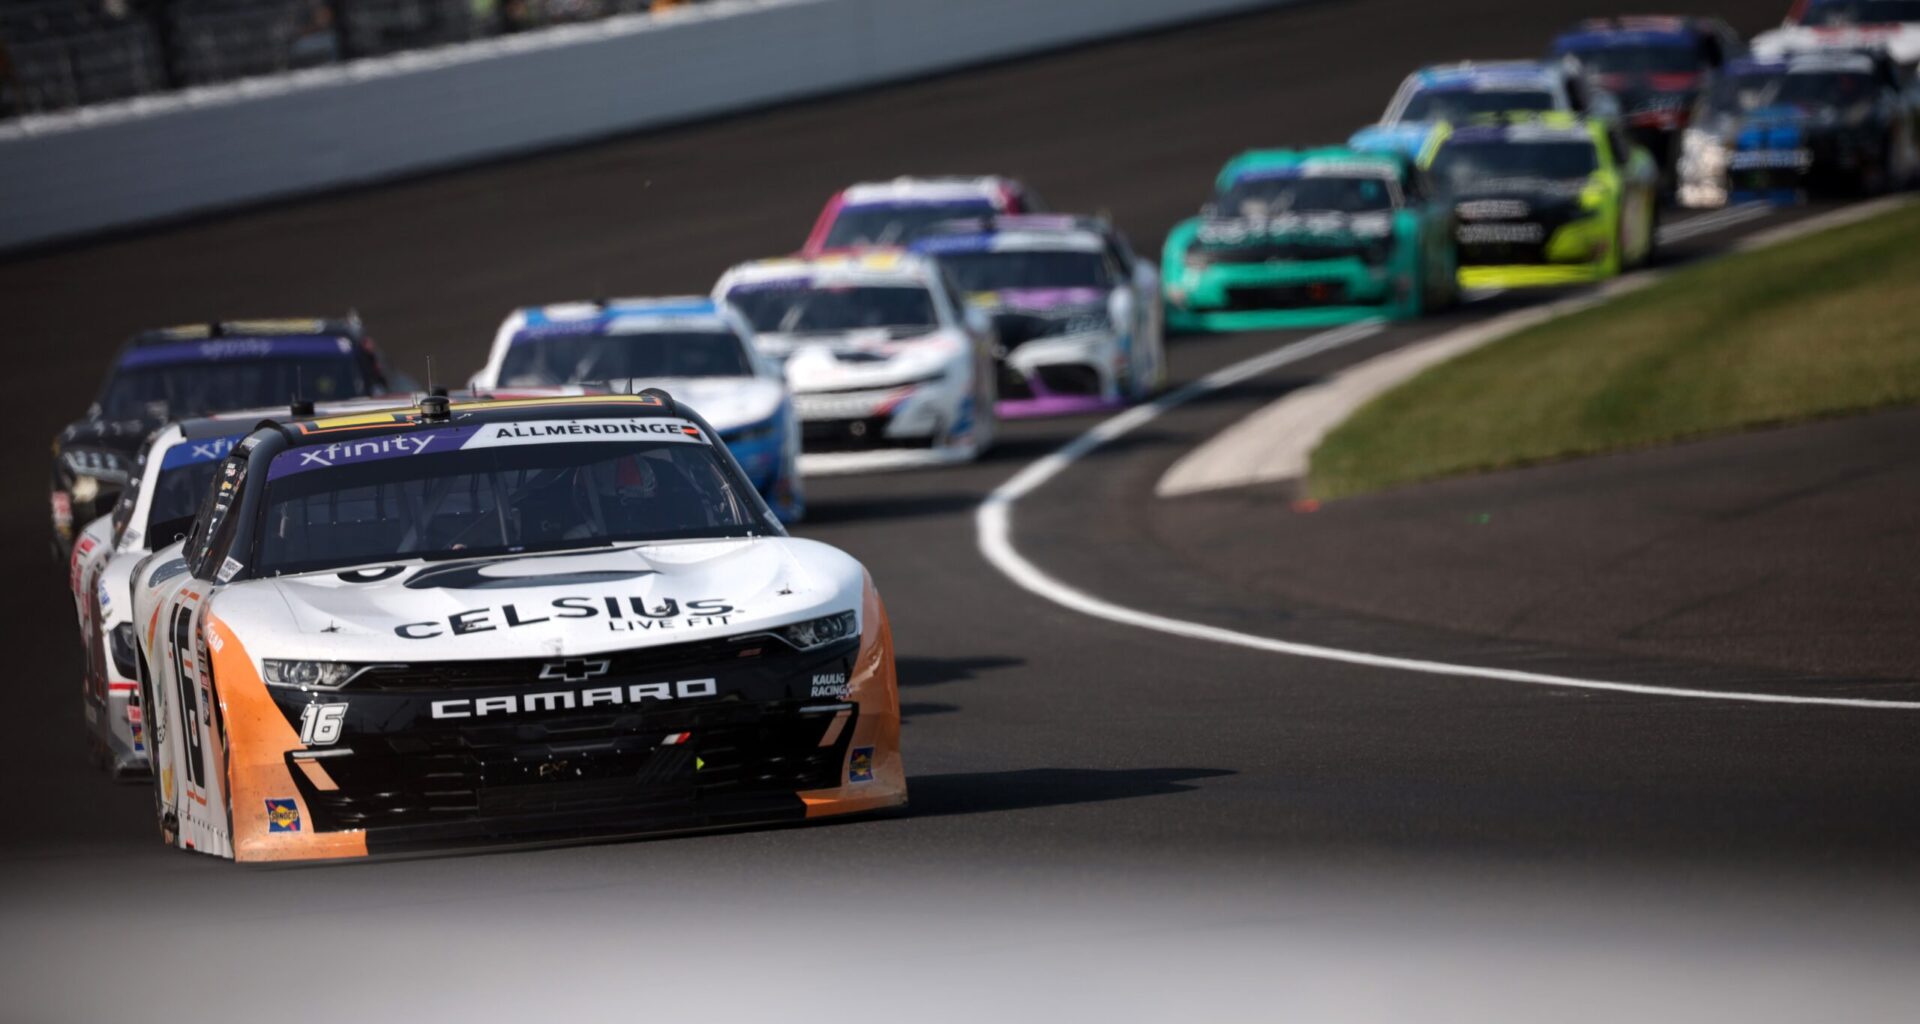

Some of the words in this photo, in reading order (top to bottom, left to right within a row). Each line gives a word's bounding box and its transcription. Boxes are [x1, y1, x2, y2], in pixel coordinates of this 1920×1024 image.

[300, 434, 436, 467] xfinity
[394, 596, 735, 640] CELSIUS
[608, 618, 674, 632] LIVE
[686, 614, 734, 628] FIT
[431, 677, 718, 719] CAMARO
[300, 702, 349, 746] 16
